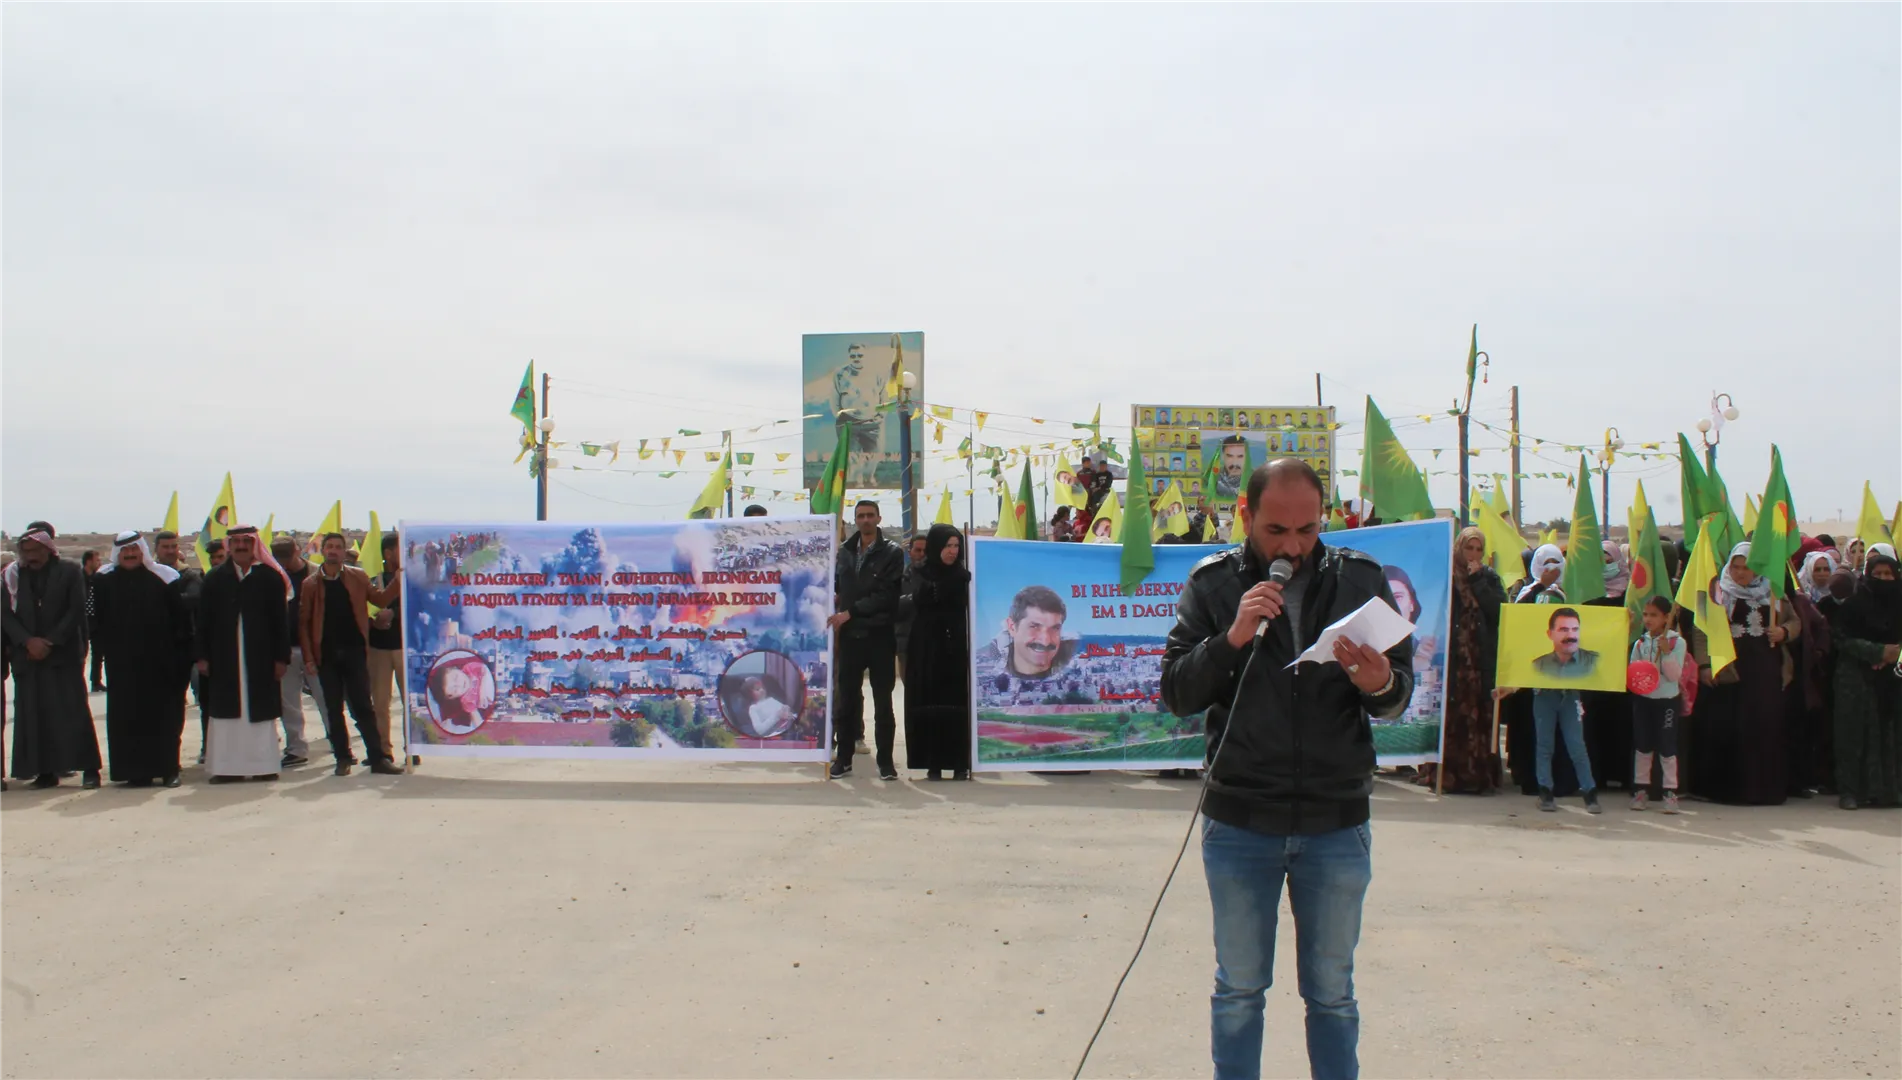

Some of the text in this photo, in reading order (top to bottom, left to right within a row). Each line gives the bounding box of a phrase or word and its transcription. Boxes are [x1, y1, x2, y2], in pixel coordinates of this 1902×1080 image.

[451, 572, 471, 587] EM
[557, 572, 602, 587] TALAN
[611, 572, 696, 586] GUHERTINA
[1071, 582, 1185, 598] BI RIH BERXW
[570, 593, 589, 606] YA
[591, 593, 604, 606] LI
[731, 592, 777, 606] DIKIN
[1091, 605, 1116, 618] EM
